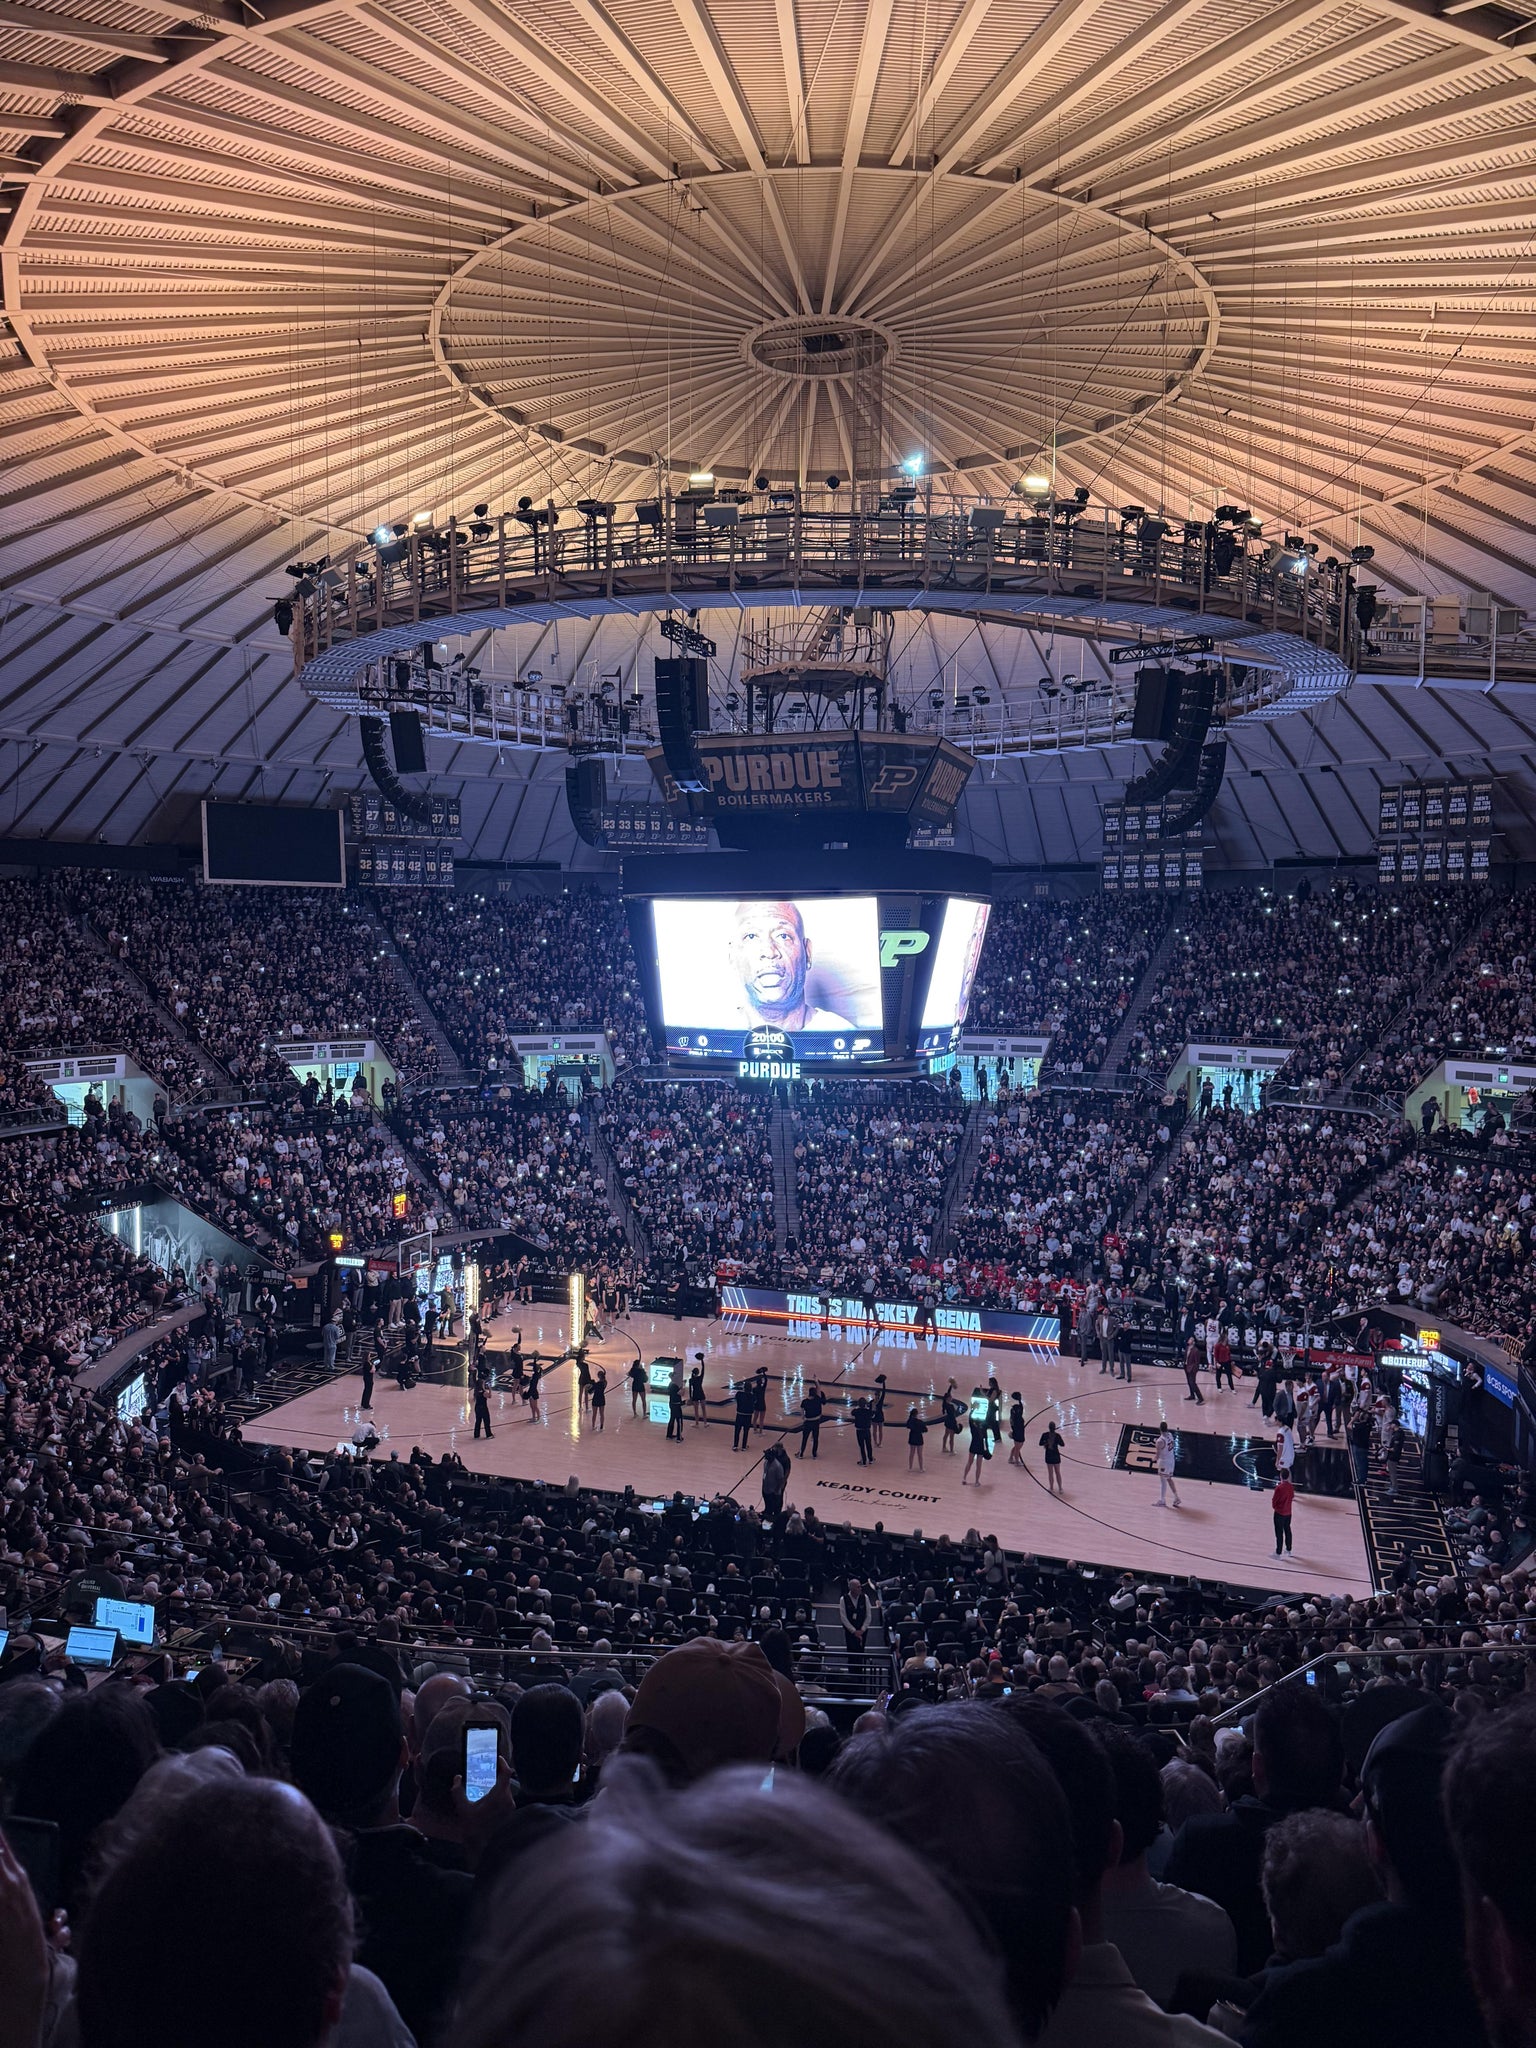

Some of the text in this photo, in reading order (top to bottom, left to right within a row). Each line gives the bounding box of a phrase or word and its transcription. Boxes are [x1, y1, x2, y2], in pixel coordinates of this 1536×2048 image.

[701, 749, 842, 793] PURDUE
[870, 765, 918, 794] P
[717, 791, 832, 807] BOILERMAKERS
[366, 811, 395, 822] 27 13
[432, 814, 459, 824] 37 19
[604, 820, 616, 829] 23
[618, 820, 630, 830] 33
[634, 821, 646, 830] 55
[650, 822, 660, 830] 13
[668, 822, 674, 830] 4
[360, 860, 453, 872] 32 35 43 42 10 22
[497, 882, 512, 892] 117
[879, 930, 930, 967] P
[752, 1032, 786, 1044] 20:00
[739, 1062, 800, 1079] PURDUE
[100, 1206, 118, 1215] PLAY
[122, 1200, 142, 1210] HARD
[244, 1264, 260, 1274] P
[787, 1294, 821, 1315] THIS
[926, 1308, 982, 1332] RENA
[1423, 1338, 1435, 1346] 30
[1336, 1355, 1354, 1364] State
[1354, 1358, 1372, 1366] Farm
[1491, 1378, 1502, 1392] CBS
[816, 1480, 942, 1503] KEADY COURT
